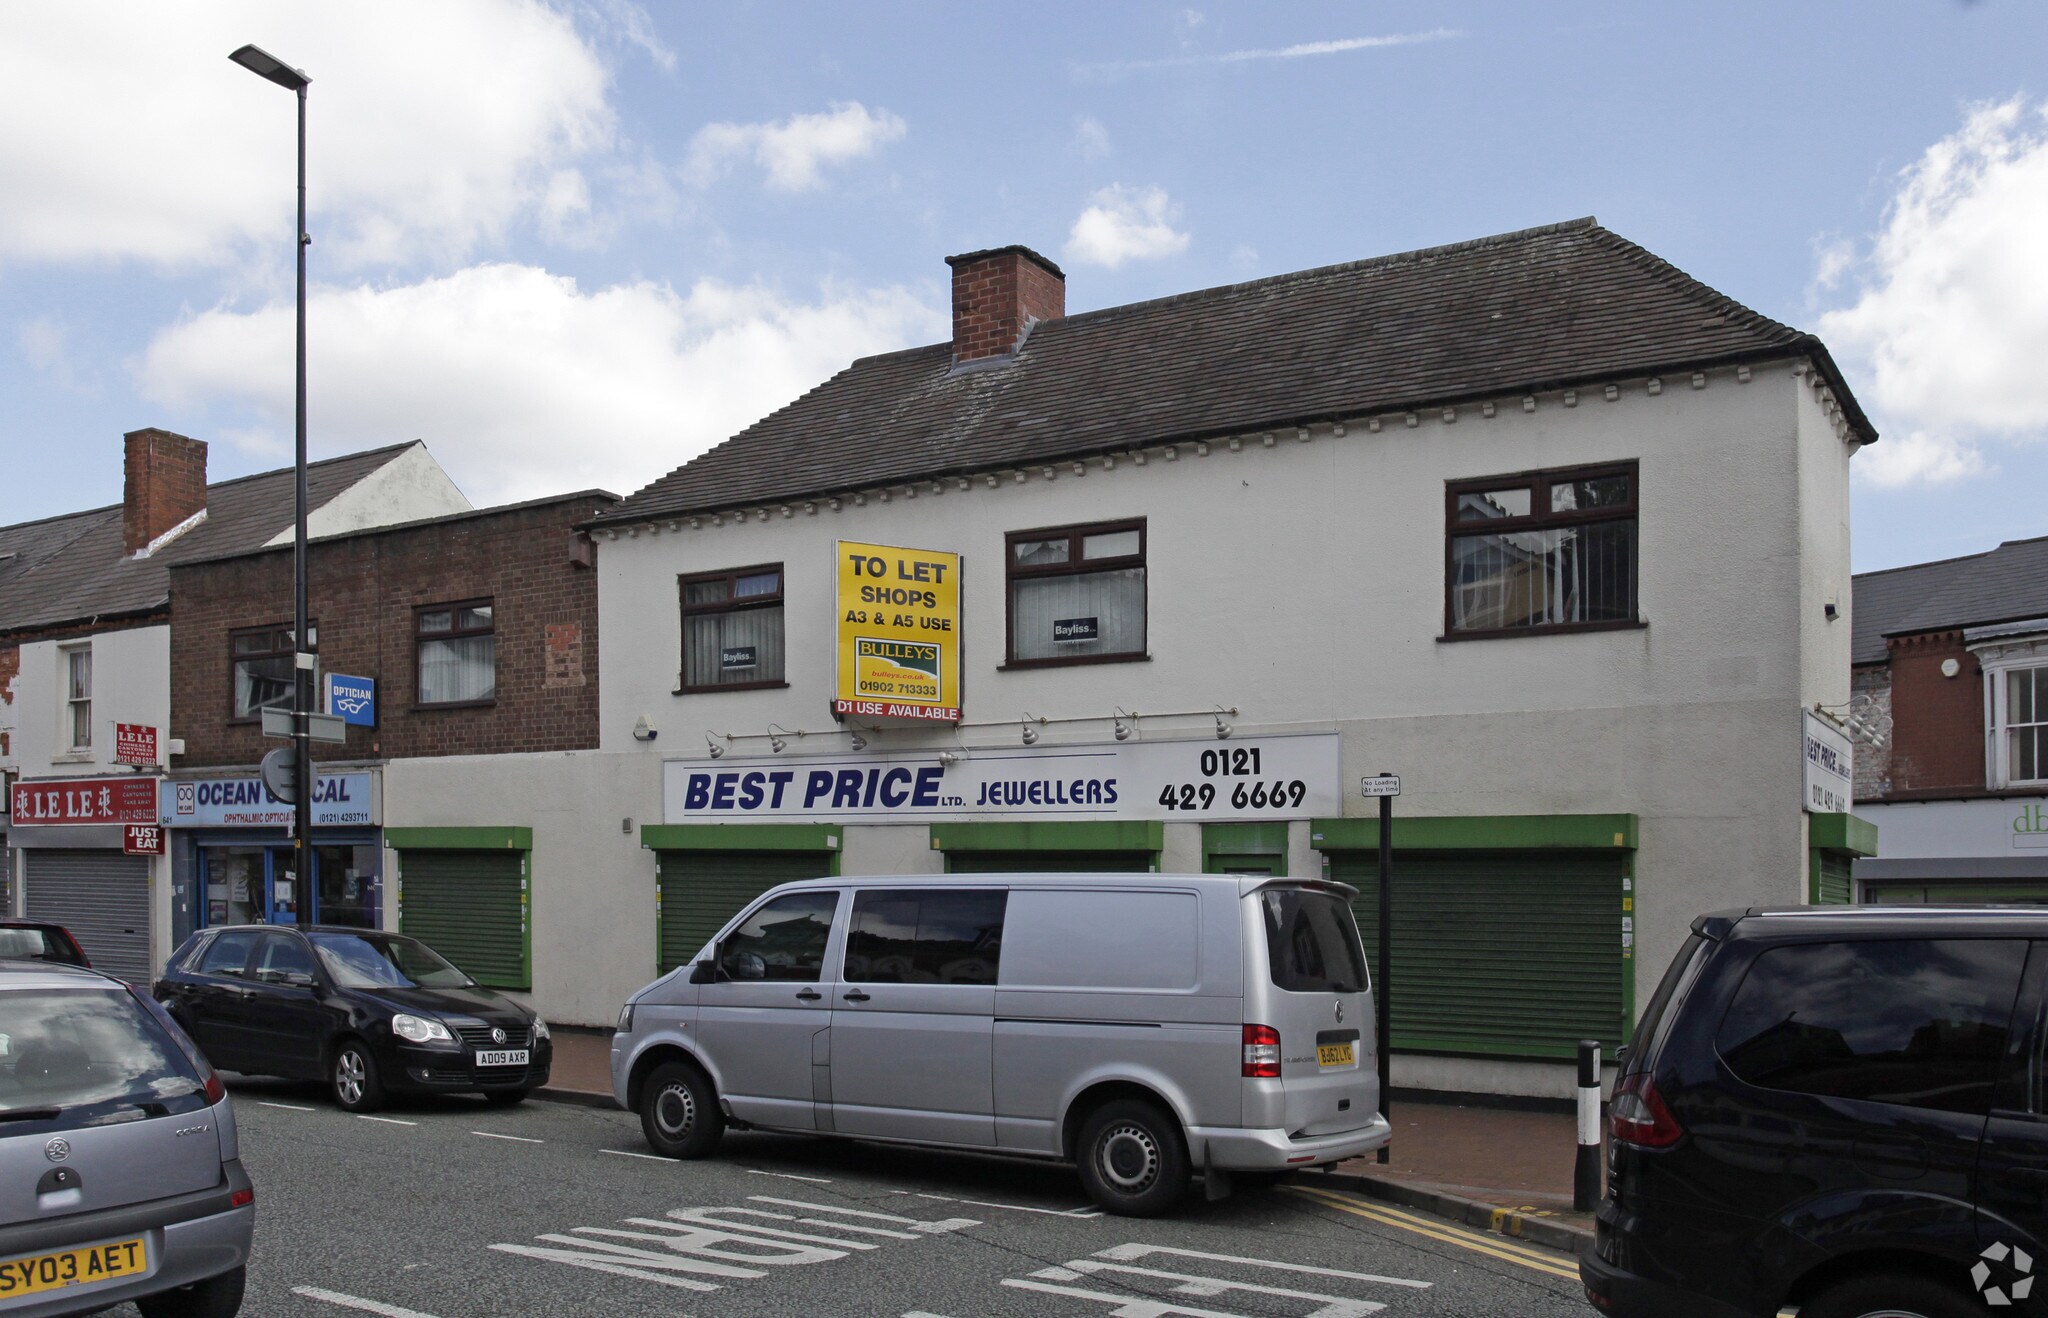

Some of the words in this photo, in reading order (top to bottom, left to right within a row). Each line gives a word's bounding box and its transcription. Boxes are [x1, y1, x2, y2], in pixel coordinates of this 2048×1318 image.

[849, 555, 886, 578] TO
[897, 559, 947, 584] LET
[861, 585, 936, 608] SHOPS
[845, 610, 867, 624] A3
[873, 612, 885, 625] &
[892, 614, 914, 627] A5
[920, 617, 951, 631] USE
[1055, 624, 1089, 636] Bayliss
[723, 652, 750, 662] Bayliss
[860, 642, 935, 660] BULLEYS
[871, 670, 925, 681] bulleys.co.uk
[333, 686, 372, 700] OPTICIAN
[860, 681, 894, 693] 01902
[898, 684, 936, 696] 713333
[837, 700, 853, 712] D1
[857, 702, 883, 715] USE
[888, 703, 958, 720] AVAILABLE
[1199, 747, 1261, 777] 0121
[197, 781, 262, 805] OCEAN
[684, 771, 795, 810] BEST
[803, 766, 945, 808] PRICE
[941, 796, 967, 807] LTD.
[976, 778, 1118, 806] JEWELLERS
[1158, 783, 1216, 811] 429
[1231, 779, 1307, 810] 6669
[33, 791, 61, 818] LE
[66, 790, 93, 818] LE
[224, 813, 263, 824] OPHTHALMIC
[320, 813, 340, 824] (0121)
[341, 812, 368, 822] 4293711
[129, 828, 159, 838] JUST
[136, 838, 159, 848] EAT
[481, 1053, 507, 1064] AD09
[508, 1052, 526, 1063] AXR
[0, 1253, 77, 1290] SY03
[88, 1241, 139, 1275] AET
